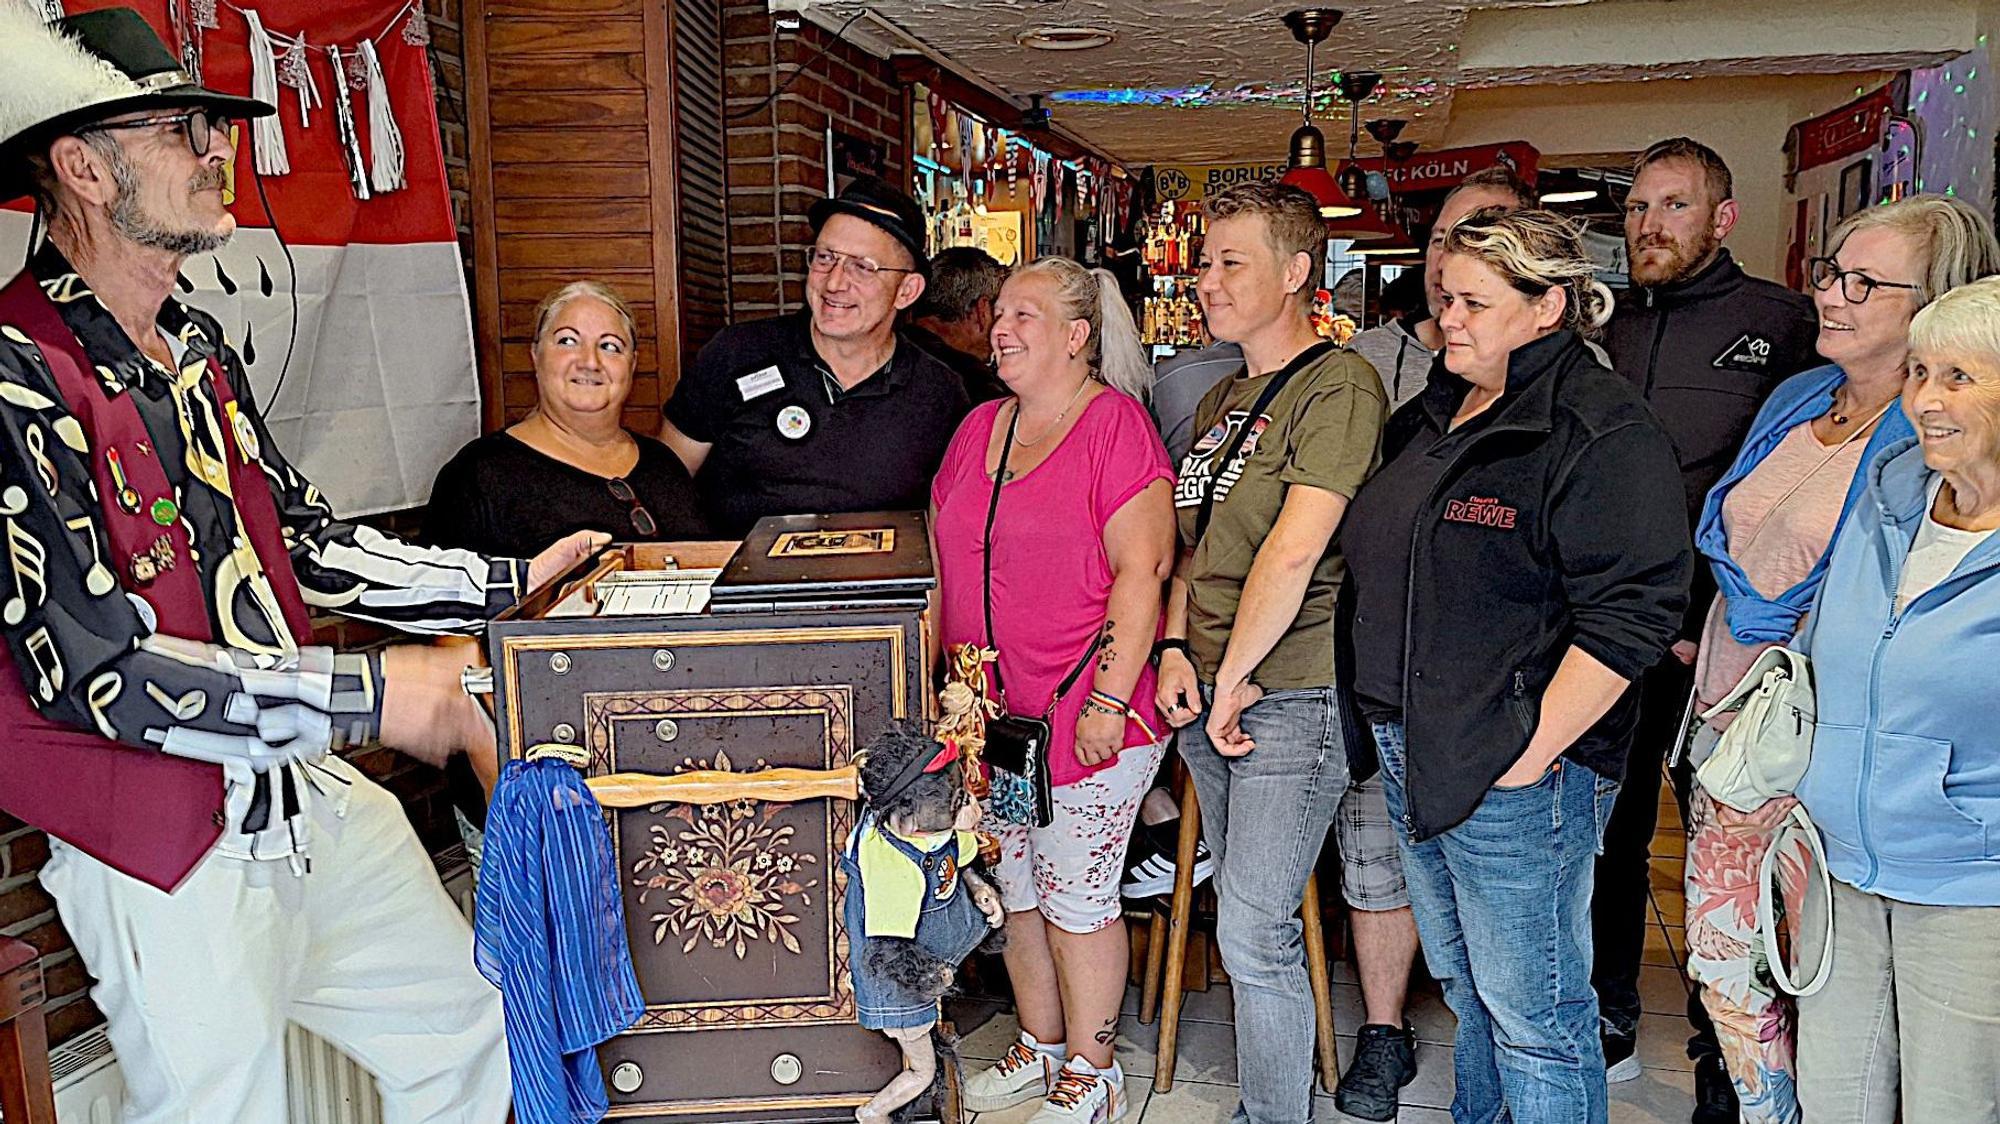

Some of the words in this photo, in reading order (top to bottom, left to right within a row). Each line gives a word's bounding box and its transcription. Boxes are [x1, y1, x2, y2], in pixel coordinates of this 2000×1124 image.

[1208, 165, 1288, 184] BORUSS
[1411, 160, 1469, 180] KÖLN
[1444, 499, 1517, 529] REWE
